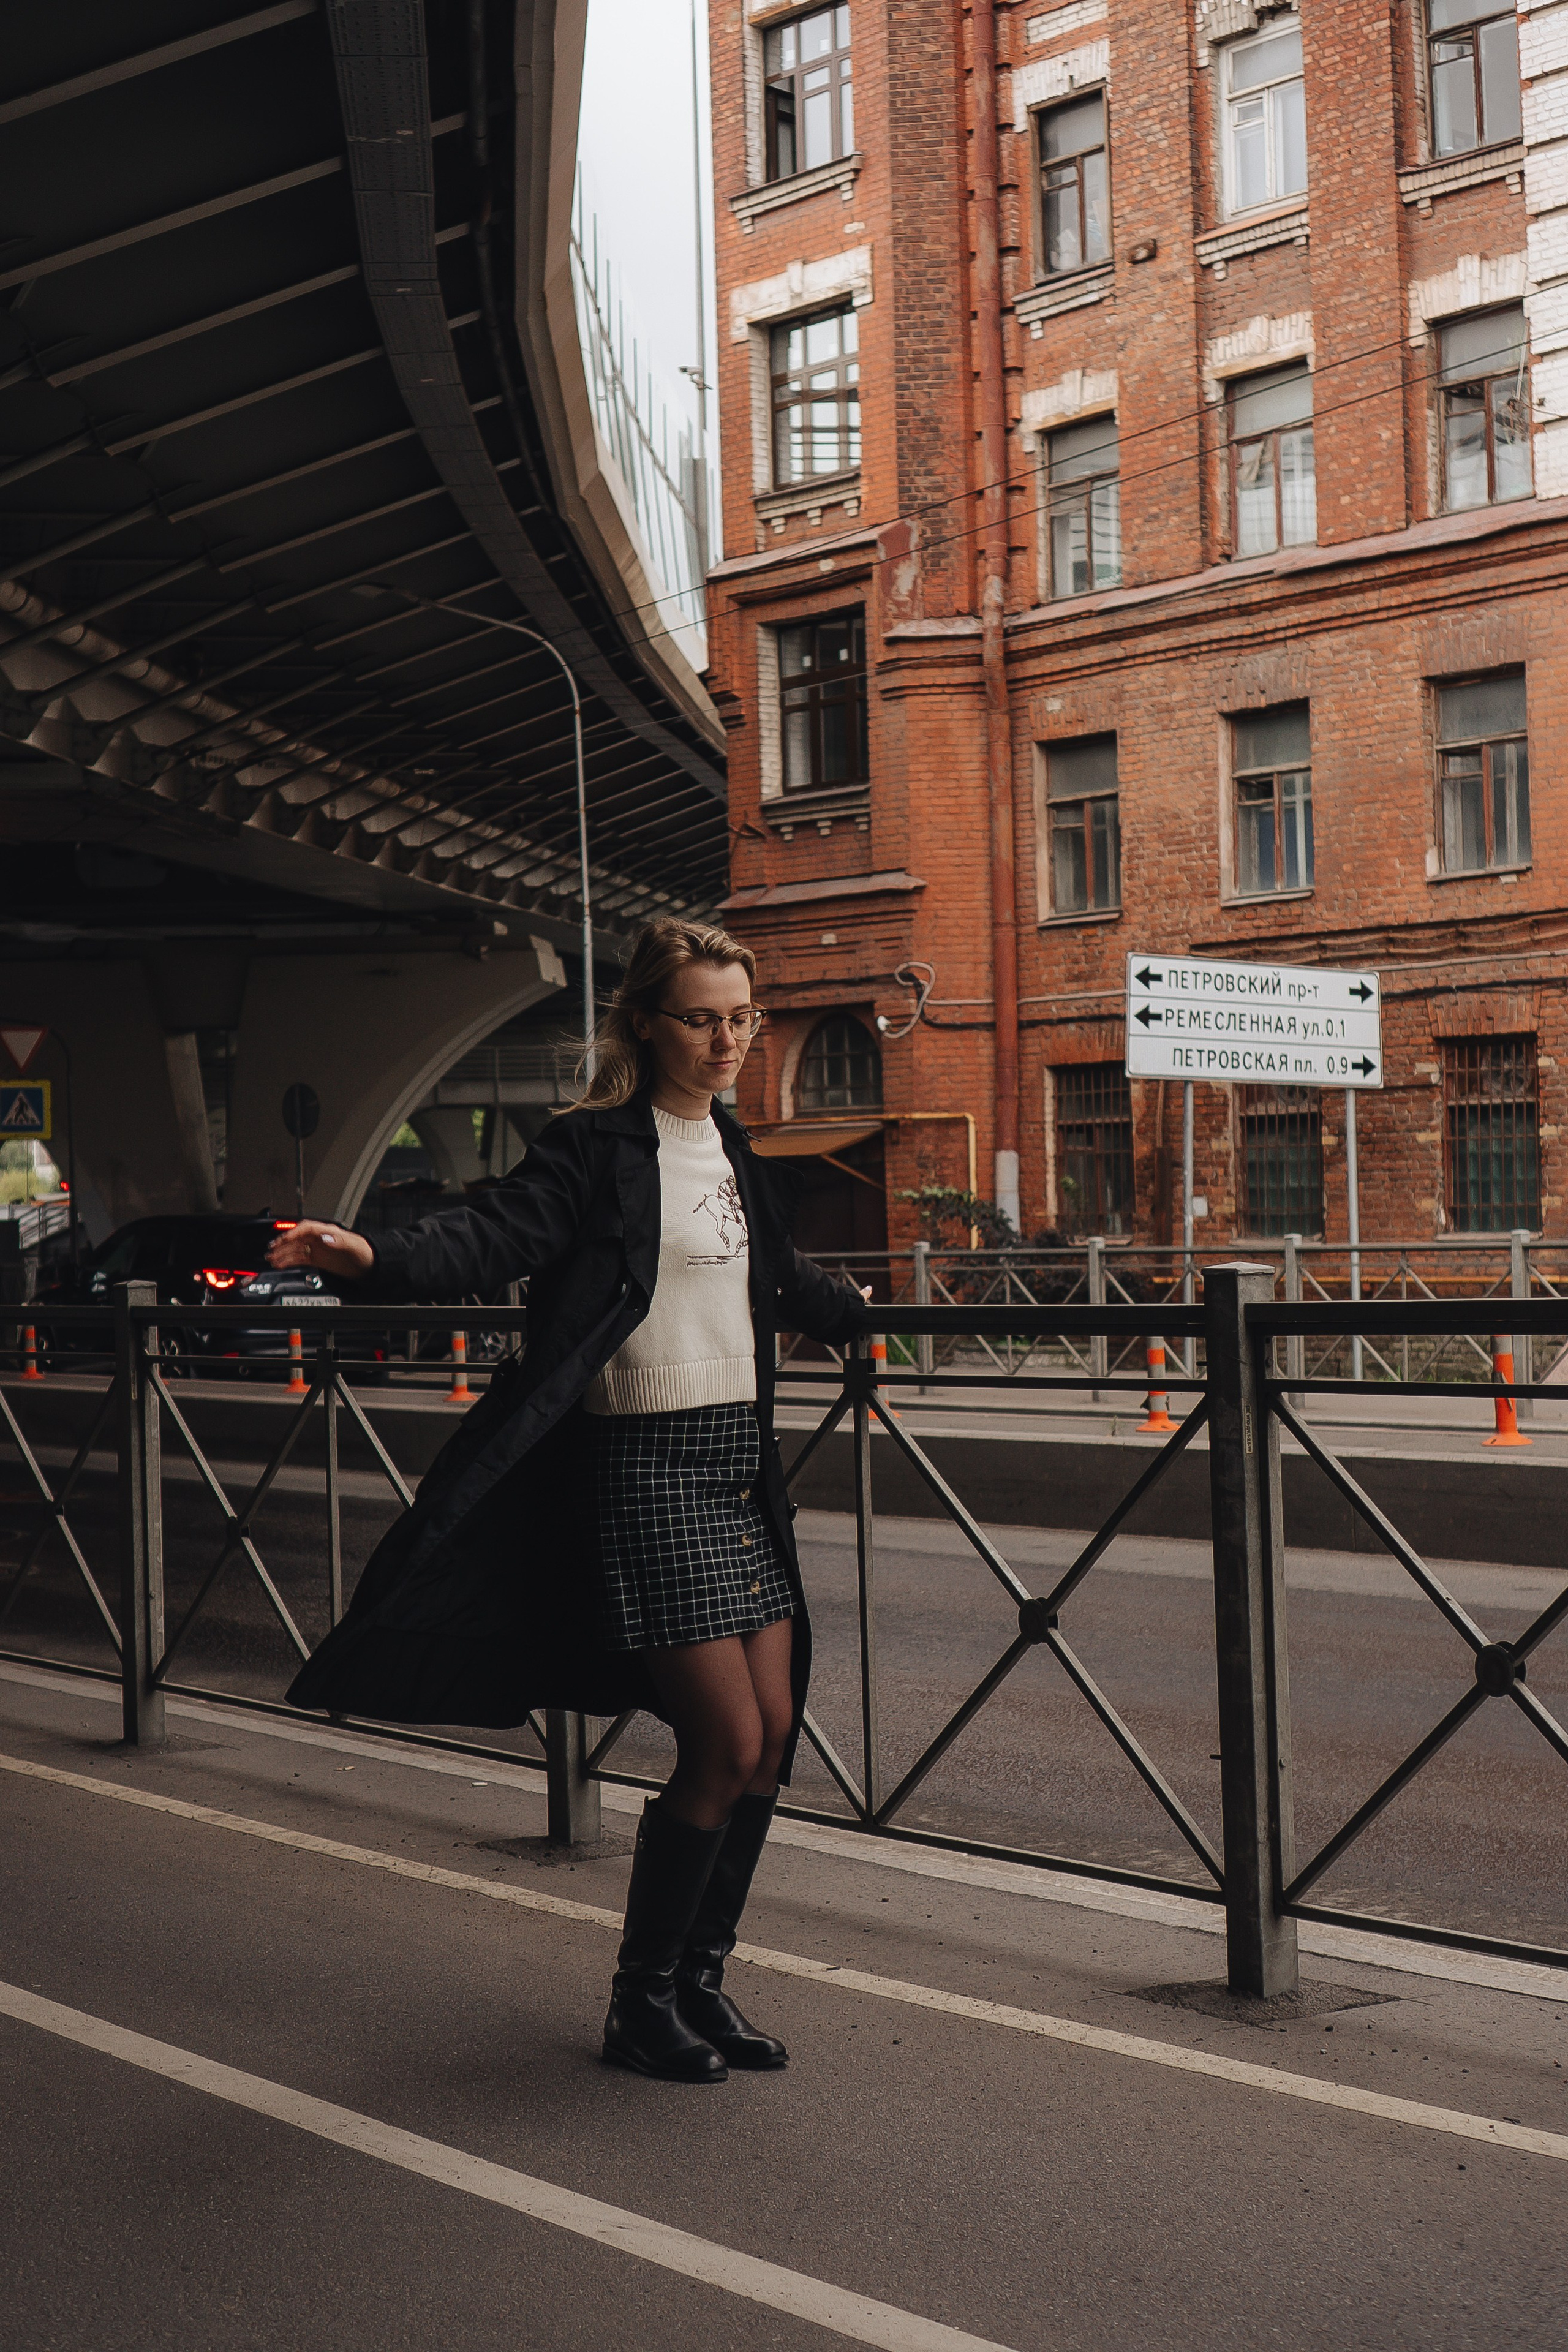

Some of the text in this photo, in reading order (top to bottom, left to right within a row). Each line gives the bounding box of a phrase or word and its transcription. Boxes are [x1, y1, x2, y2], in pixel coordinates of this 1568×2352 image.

[1168, 968, 1319, 1002] ПЕТРОВСКИЙ пр-т
[1165, 1008, 1297, 1035] РЕМЕСЛЕННАЯ
[1173, 1048, 1288, 1072] ПЕТРОВСКАЯ
[1295, 1059, 1317, 1073] пл.
